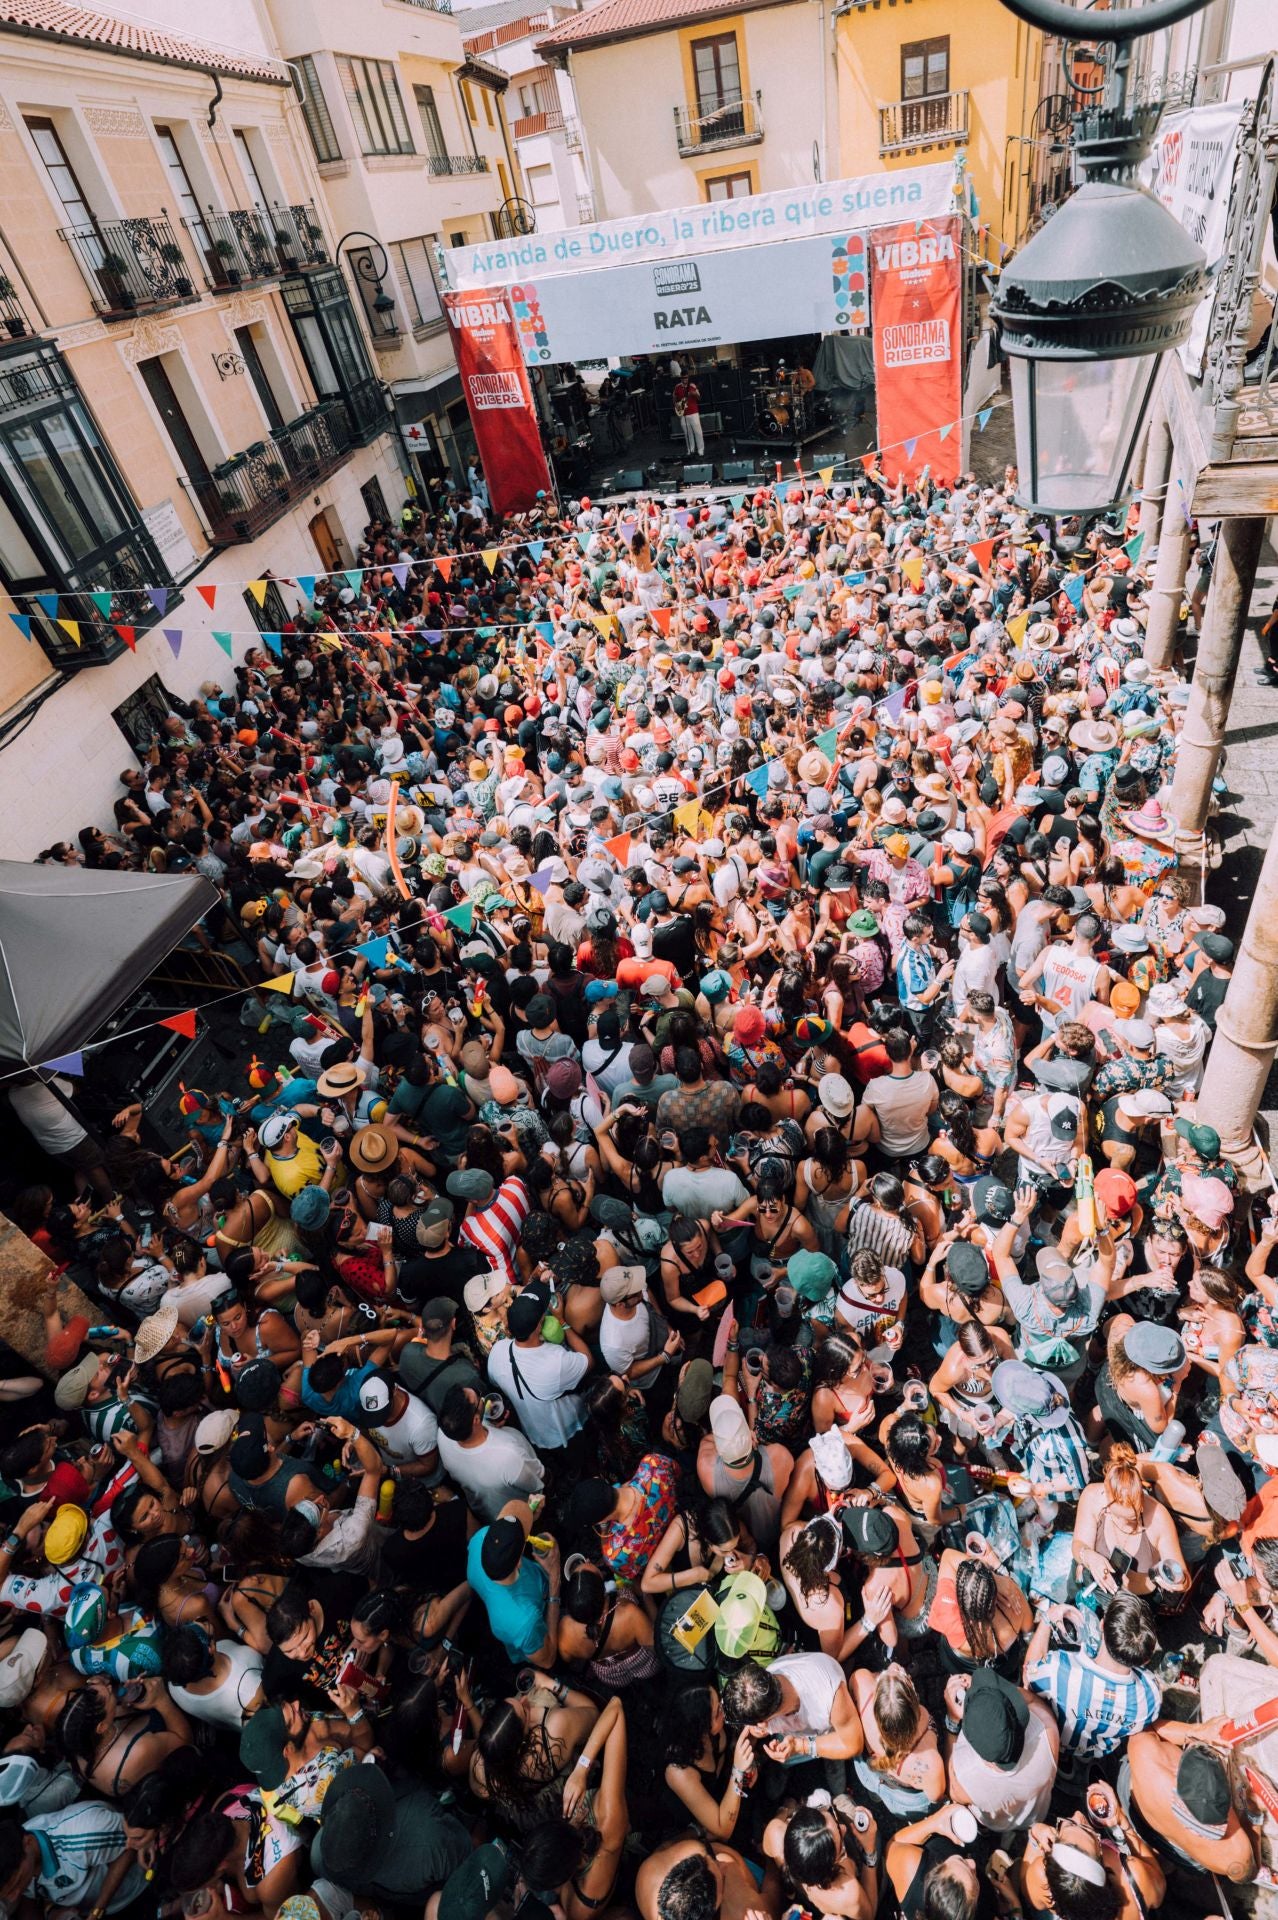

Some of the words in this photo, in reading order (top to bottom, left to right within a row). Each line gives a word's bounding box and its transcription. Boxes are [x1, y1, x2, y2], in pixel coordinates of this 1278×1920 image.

[472, 246, 547, 273] Aranda
[554, 238, 581, 259] de
[588, 226, 666, 255] Duero,
[673, 217, 694, 240] la
[702, 207, 775, 235] ribera
[784, 197, 833, 223] que
[842, 182, 922, 207] suena
[875, 234, 956, 271] VIBRA
[654, 263, 698, 286] SONORAMA
[448, 301, 511, 328] VIBRA
[654, 306, 712, 330] RATA
[884, 321, 945, 350] SONORAMA
[469, 373, 518, 396] SONORAMA
[658, 792, 679, 803] 26
[1055, 985, 1072, 1007] 4
